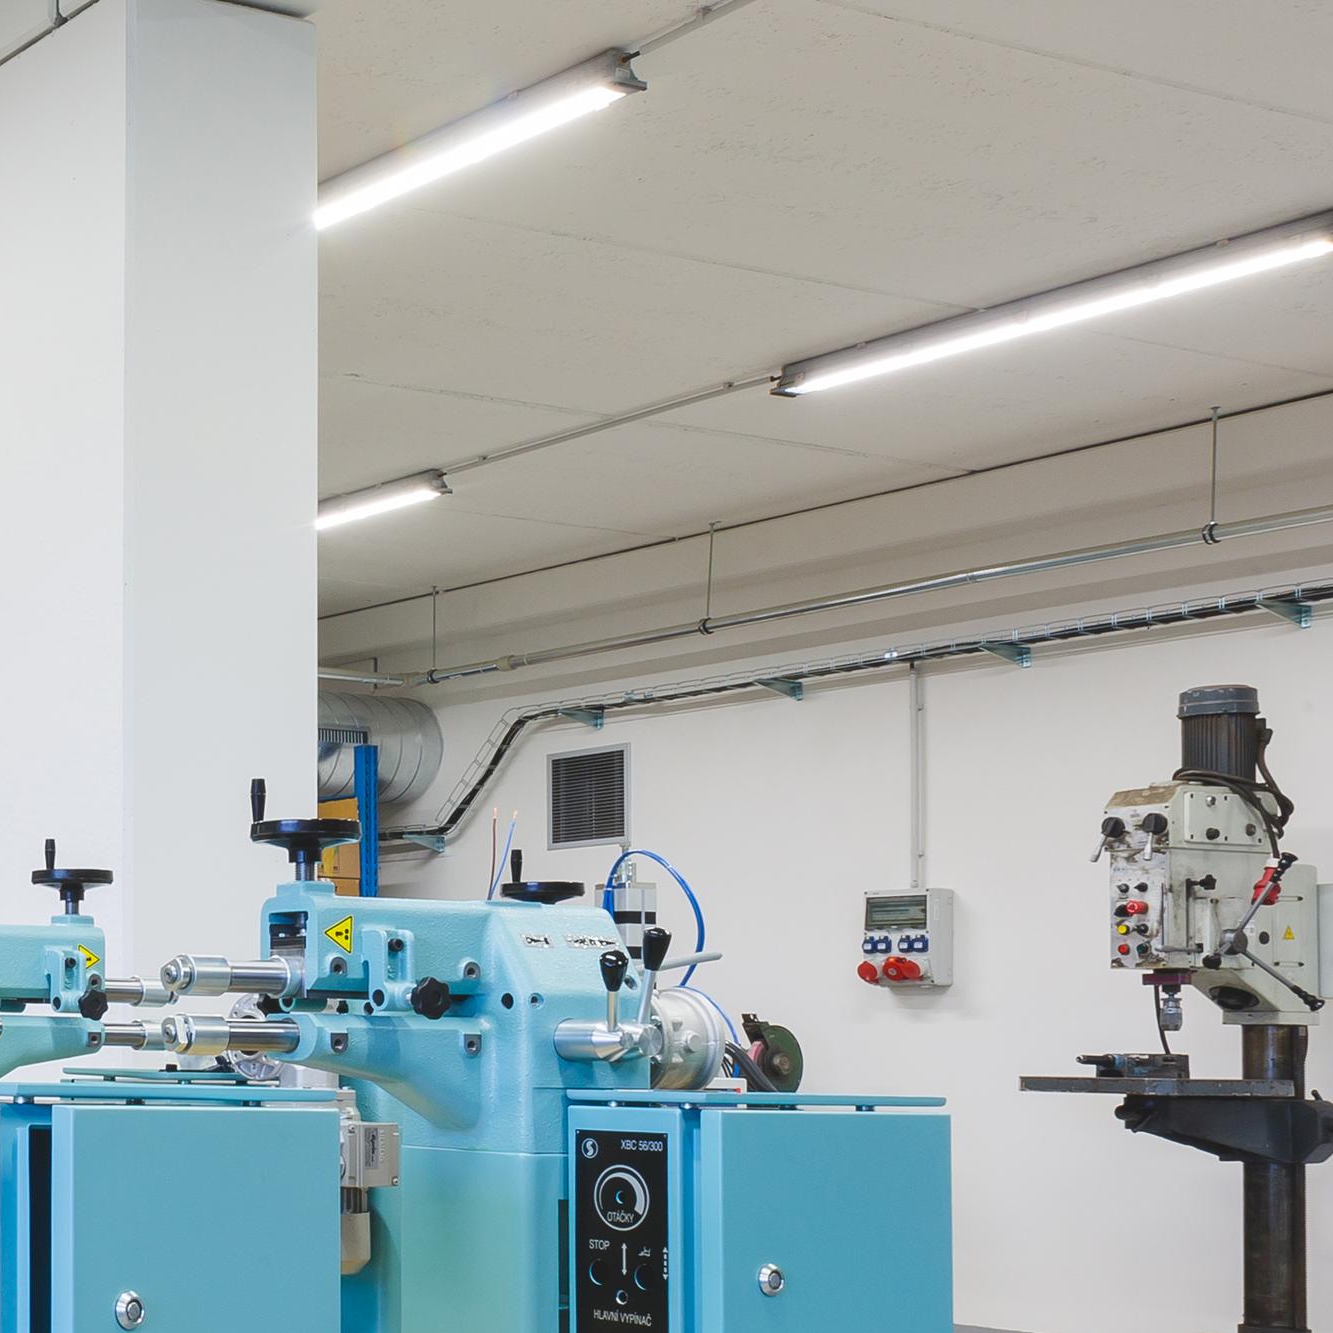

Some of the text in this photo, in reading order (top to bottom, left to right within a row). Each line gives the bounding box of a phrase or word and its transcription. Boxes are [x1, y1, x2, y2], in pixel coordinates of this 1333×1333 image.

[620, 1139, 664, 1152] XBC 56/300
[588, 1238, 611, 1251] STOP
[593, 1308, 652, 1327] HLAVNÍ VYPÍNAČ
